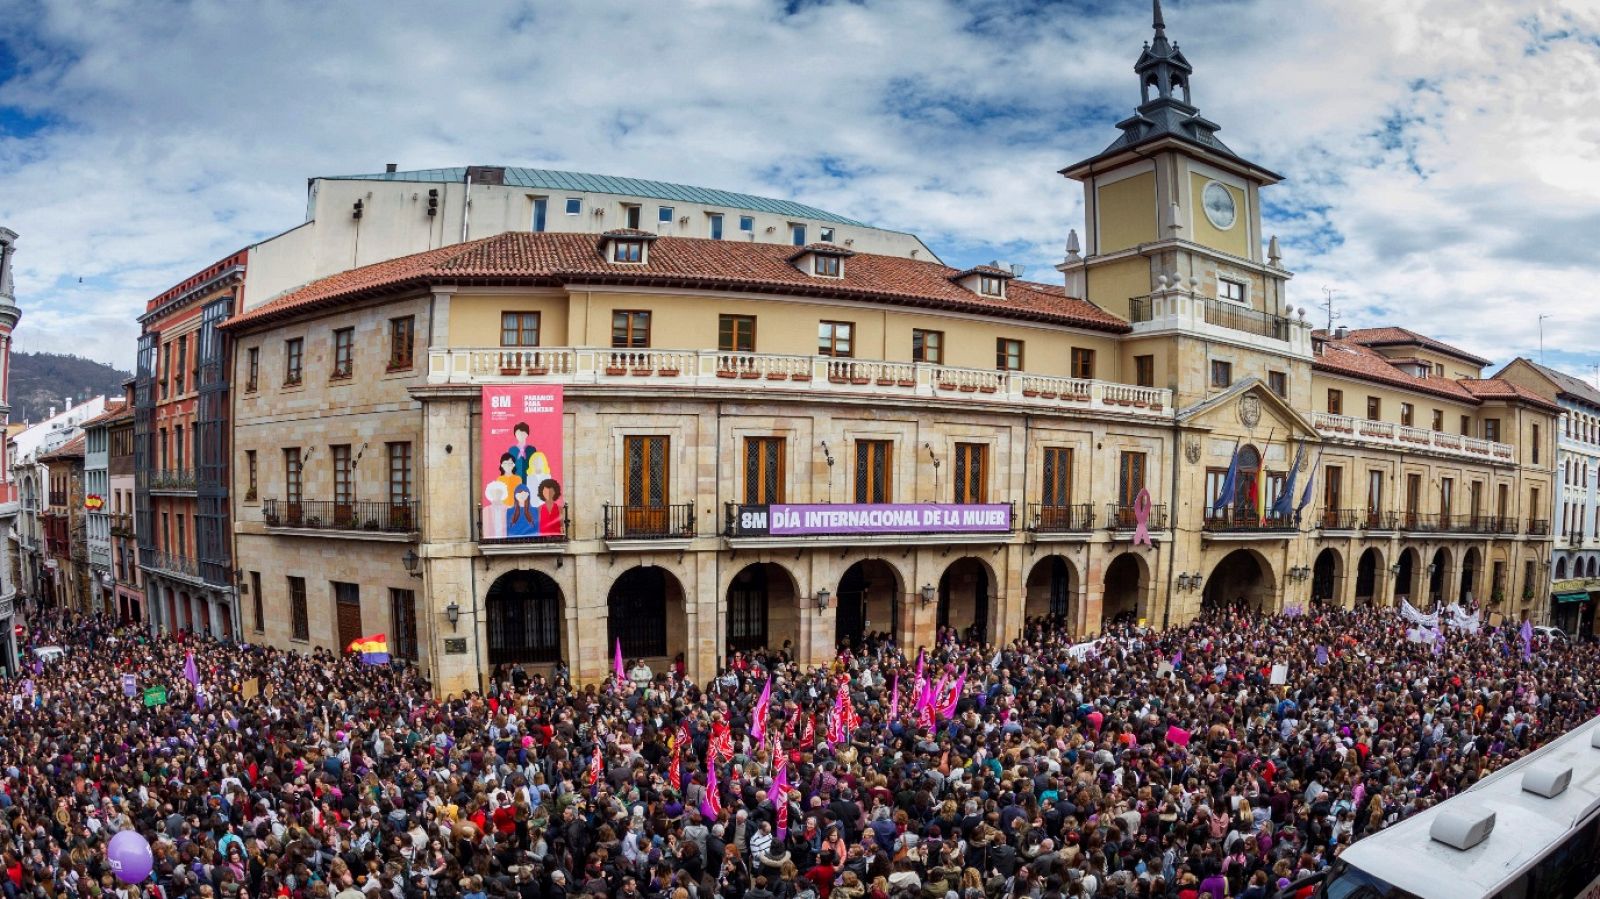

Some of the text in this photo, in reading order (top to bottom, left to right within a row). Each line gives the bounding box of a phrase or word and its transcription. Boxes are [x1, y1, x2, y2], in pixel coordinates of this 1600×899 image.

[491, 395, 511, 408] 8M
[741, 507, 1005, 529] 8M DÍA INTERNACIONAL DE LA MUJER
